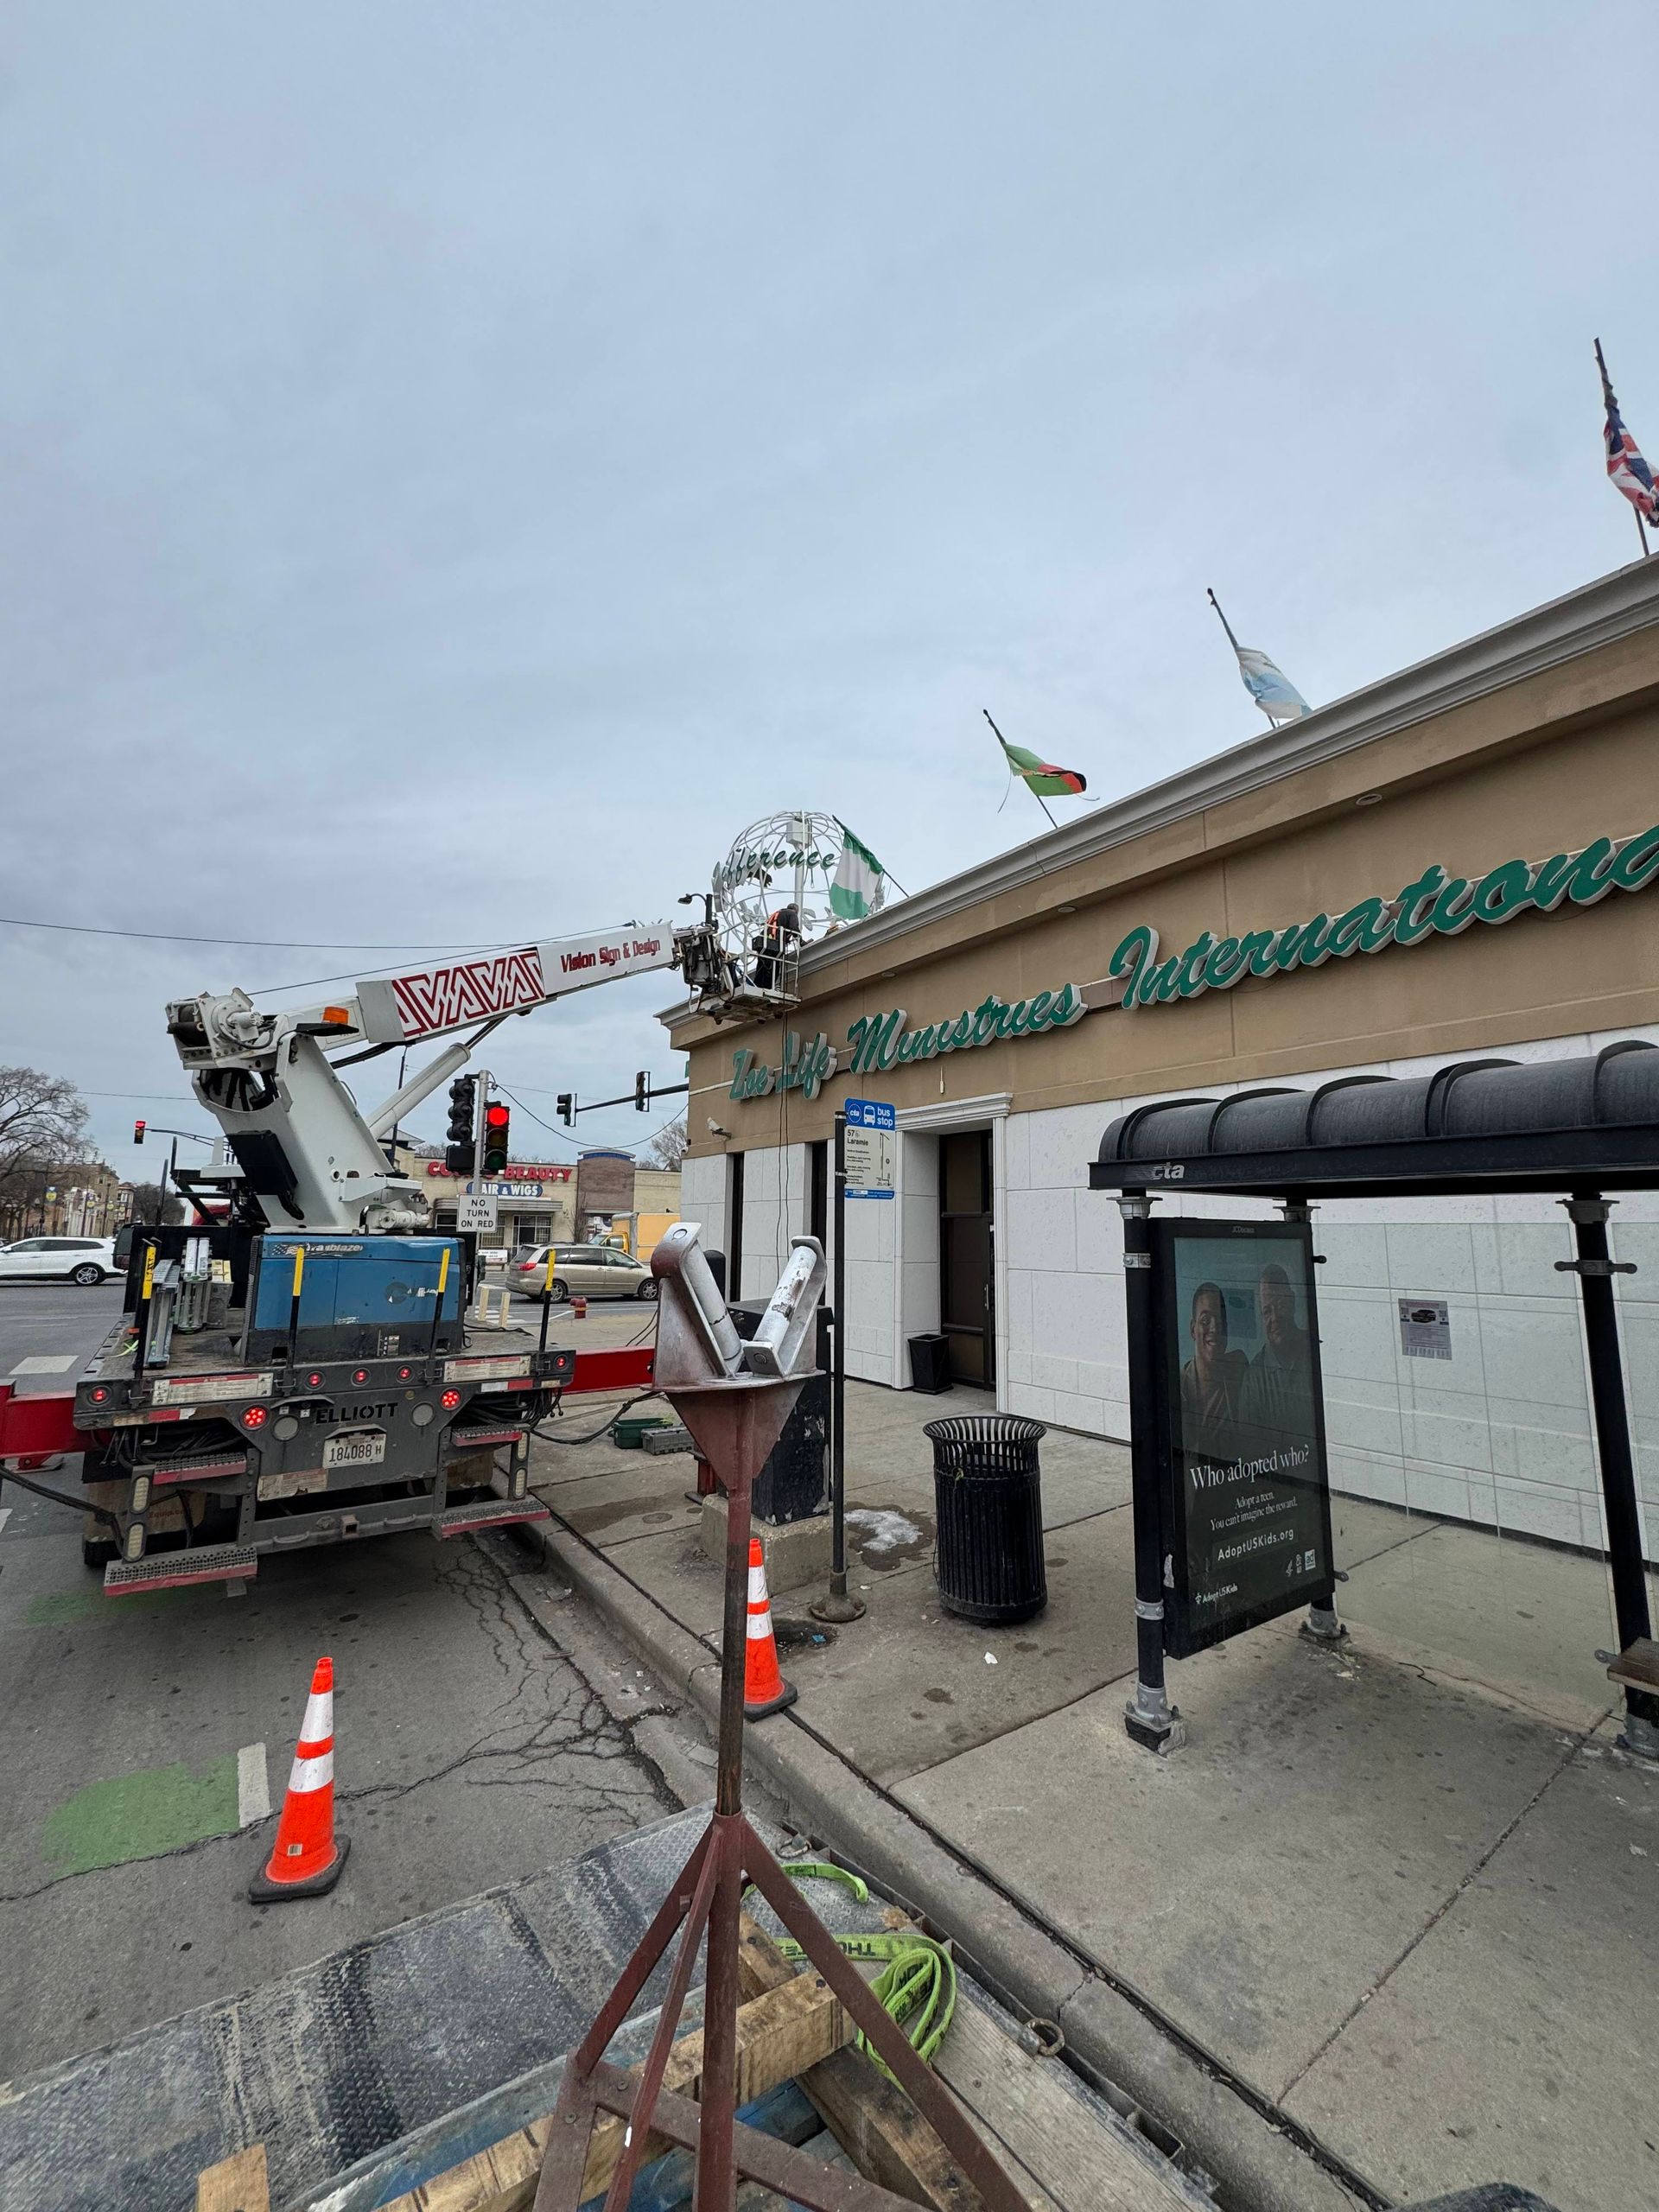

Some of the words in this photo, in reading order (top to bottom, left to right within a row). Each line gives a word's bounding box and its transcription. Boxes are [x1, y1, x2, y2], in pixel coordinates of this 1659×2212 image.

[715, 846, 836, 895] ifference
[561, 951, 596, 973] Vision
[599, 946, 621, 967] Sign
[623, 942, 631, 958] &
[632, 938, 661, 957] Design
[728, 1048, 772, 1100] Zoe
[775, 1032, 836, 1100] Life
[847, 983, 1087, 1074] Ministries
[877, 1106, 891, 1117] bus
[877, 1116, 893, 1128] stop
[847, 1137, 869, 1146] Laramie
[504, 1166, 573, 1182] BEAUTY
[1152, 1162, 1185, 1180] cta
[502, 1186, 509, 1195] &
[511, 1184, 538, 1196] WIGS
[471, 1198, 486, 1207] NO
[315, 1402, 398, 1424] ELLIOTT
[329, 1444, 372, 1462] 184088
[375, 1445, 382, 1454] H
[1190, 1465, 1224, 1490] Who
[1227, 1450, 1278, 1483] adopted
[1280, 1444, 1310, 1468] who?
[1235, 1497, 1255, 1510] Adopt
[1260, 1491, 1274, 1503] teen.
[1211, 1518, 1224, 1531] You
[1225, 1513, 1241, 1528] can't
[1240, 1507, 1264, 1522] imagine
[1265, 1503, 1275, 1514] the
[1275, 1497, 1298, 1511] reward.
[1217, 1529, 1294, 1561] AdoptUSKids.org
